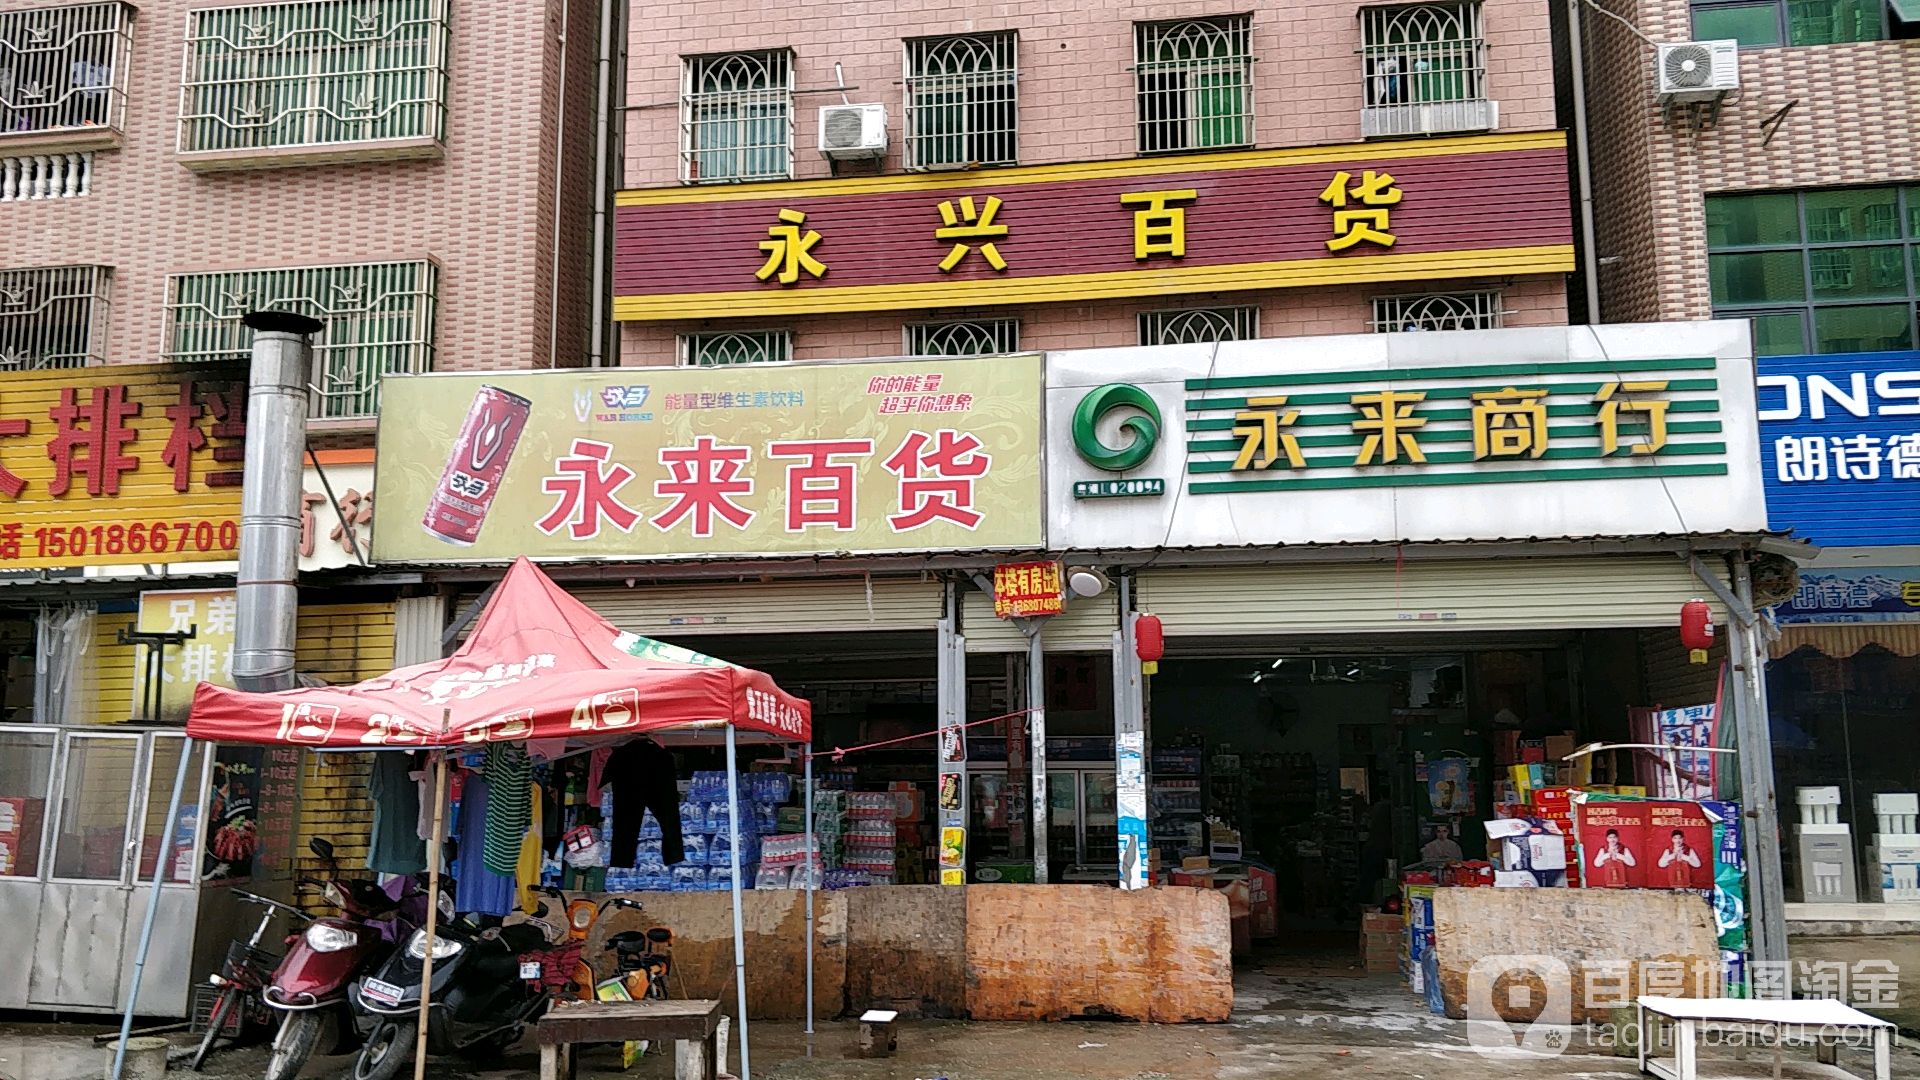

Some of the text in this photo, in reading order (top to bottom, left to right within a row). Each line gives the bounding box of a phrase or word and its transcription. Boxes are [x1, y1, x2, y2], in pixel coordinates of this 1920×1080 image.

[755, 170, 1403, 285] 永兴百货
[664, 389, 805, 410] 能量型维生素饮料
[867, 374, 942, 393] 你的能量
[879, 393, 972, 413] 超乎你想象
[1231, 380, 1671, 471] 永来商行
[1775, 432, 1920, 482] 朗诗德
[535, 429, 993, 540] 永来百货
